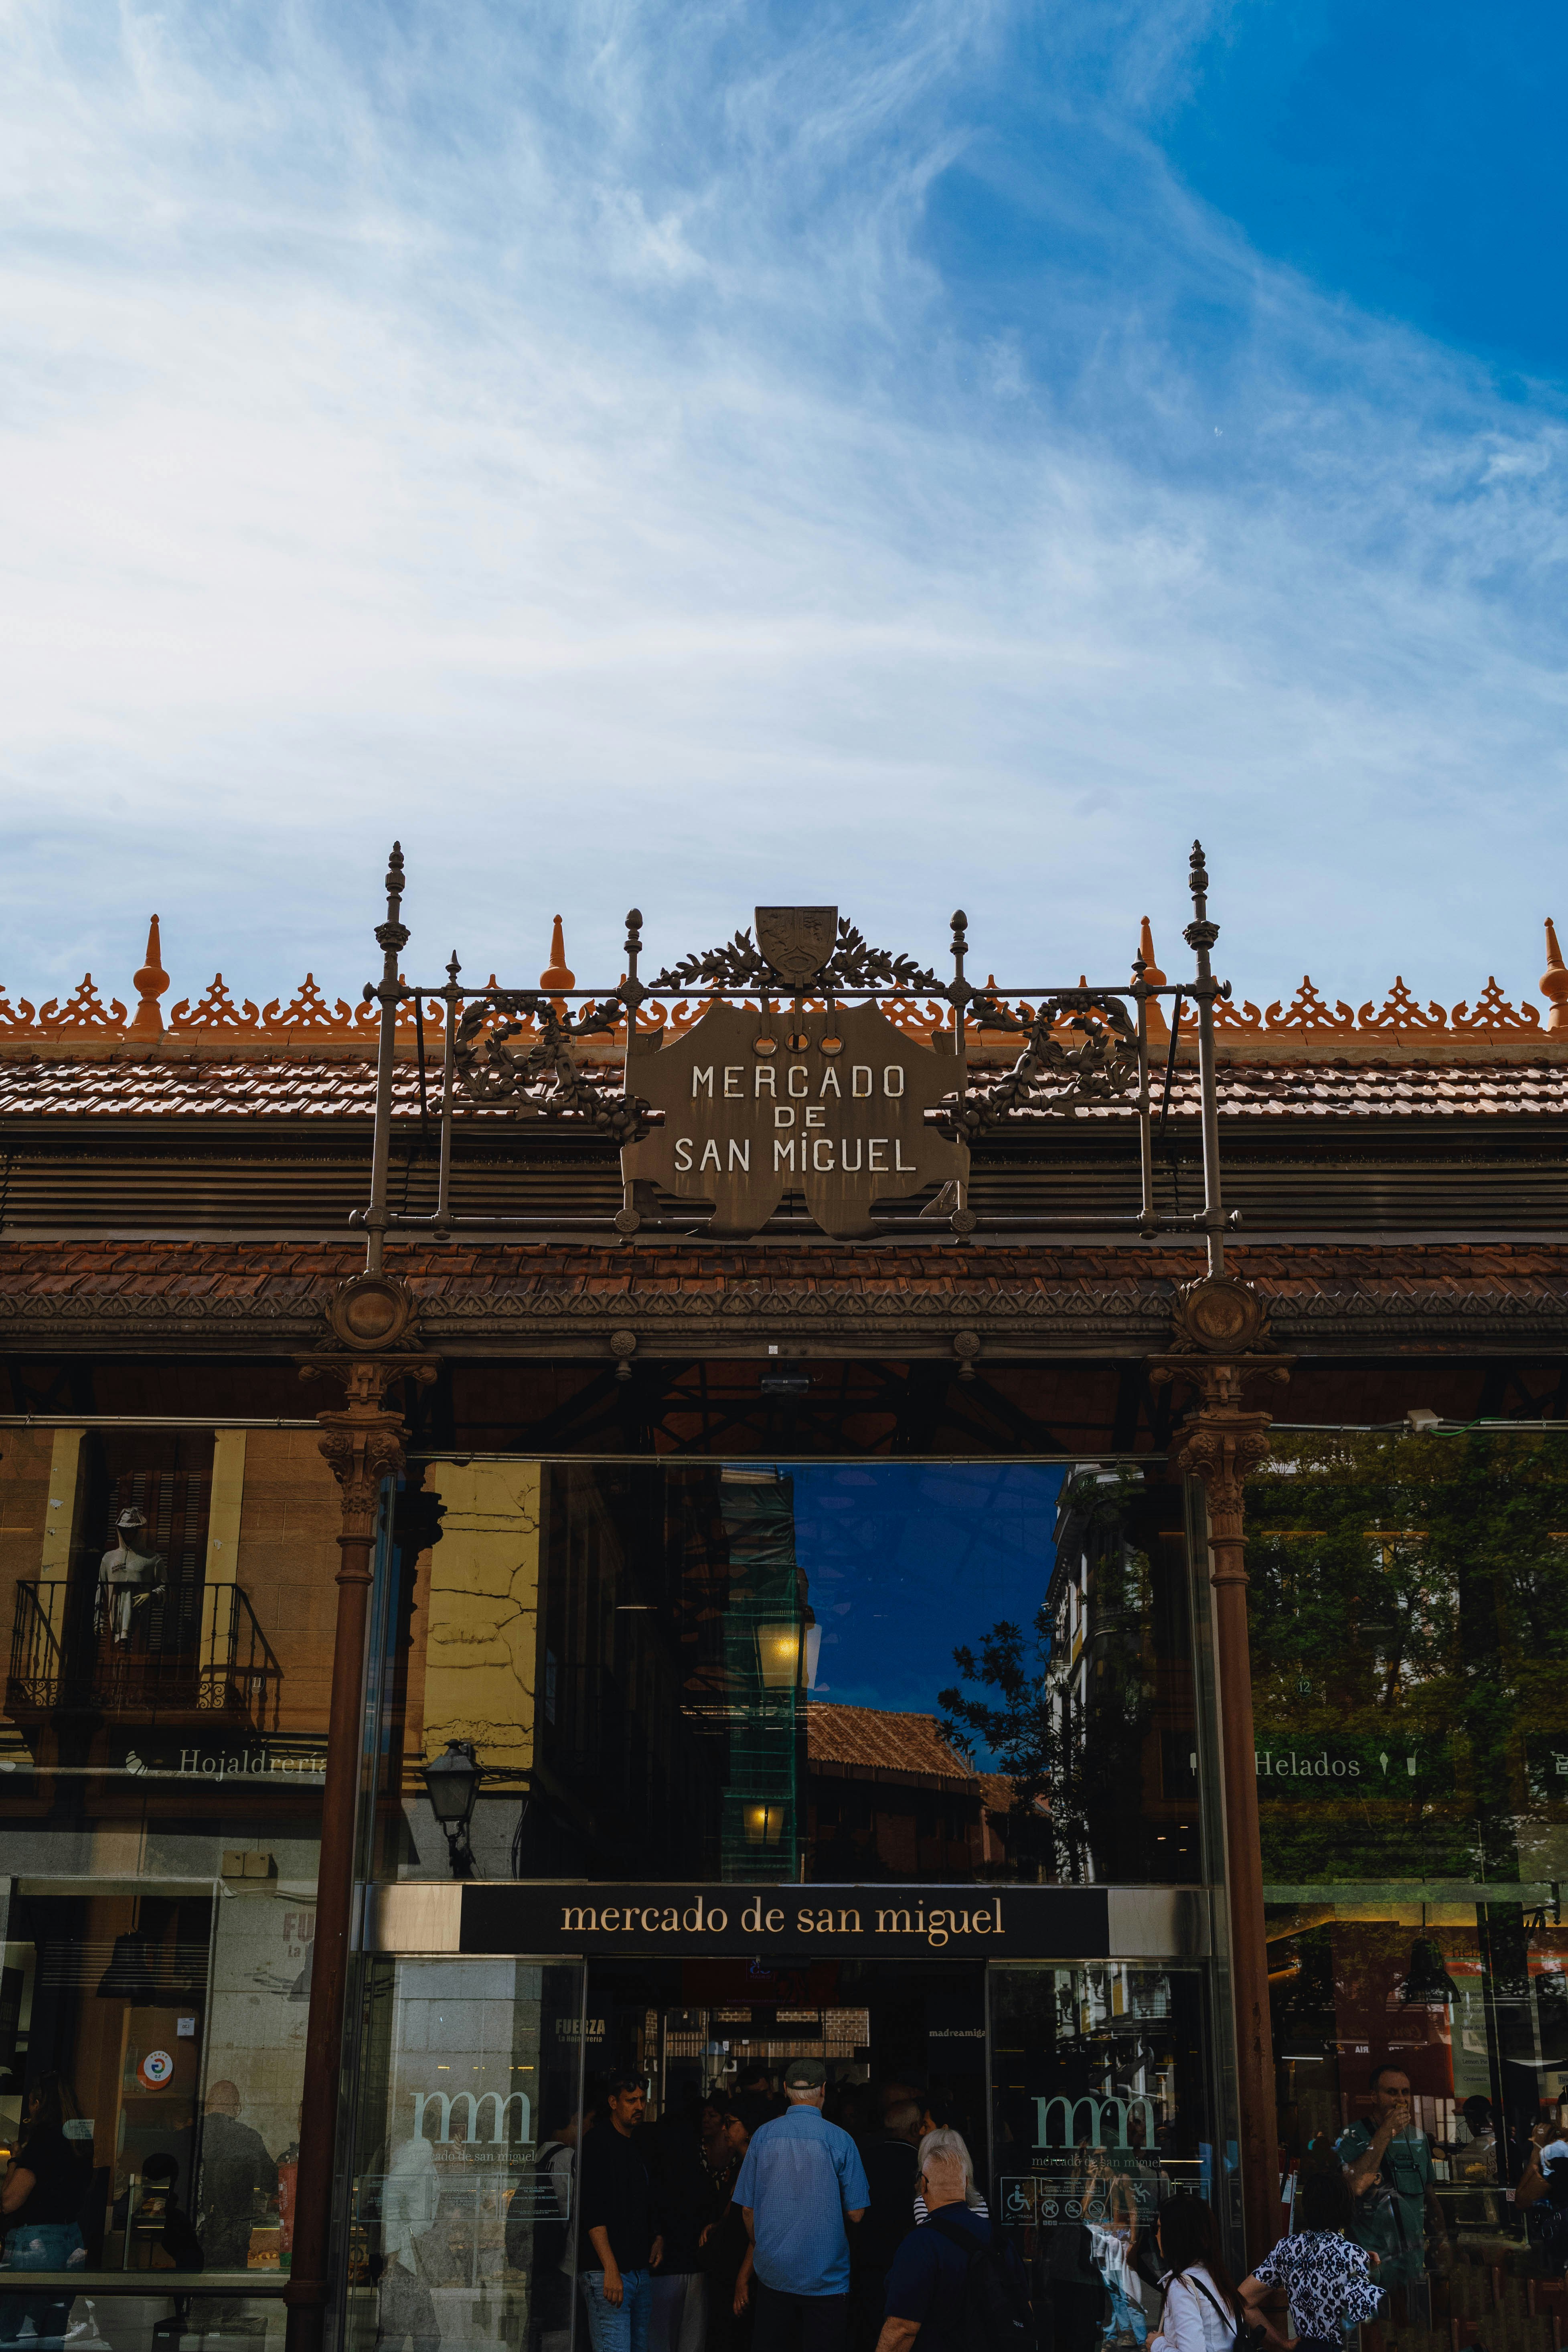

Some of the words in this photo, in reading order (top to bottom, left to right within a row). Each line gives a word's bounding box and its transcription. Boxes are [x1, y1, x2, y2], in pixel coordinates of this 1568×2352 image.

[692, 1066, 905, 1098] MERCADO
[774, 1106, 826, 1128] DE
[675, 1138, 750, 1172] SAN
[253, 1677, 262, 1688] 11
[1298, 1681, 1310, 1692] 12
[180, 1749, 327, 1782] Hojaldrería
[1255, 1751, 1360, 1776] Helados
[561, 1896, 728, 1932] mercado
[741, 1896, 784, 1933] de
[797, 1909, 863, 1933] san
[875, 1897, 1006, 1947] miguel
[929, 2028, 985, 2038] madreamiga
[458, 2150, 472, 2161] de
[474, 2153, 494, 2161] san
[497, 2150, 535, 2166] miguel
[1102, 2159, 1120, 2167] san
